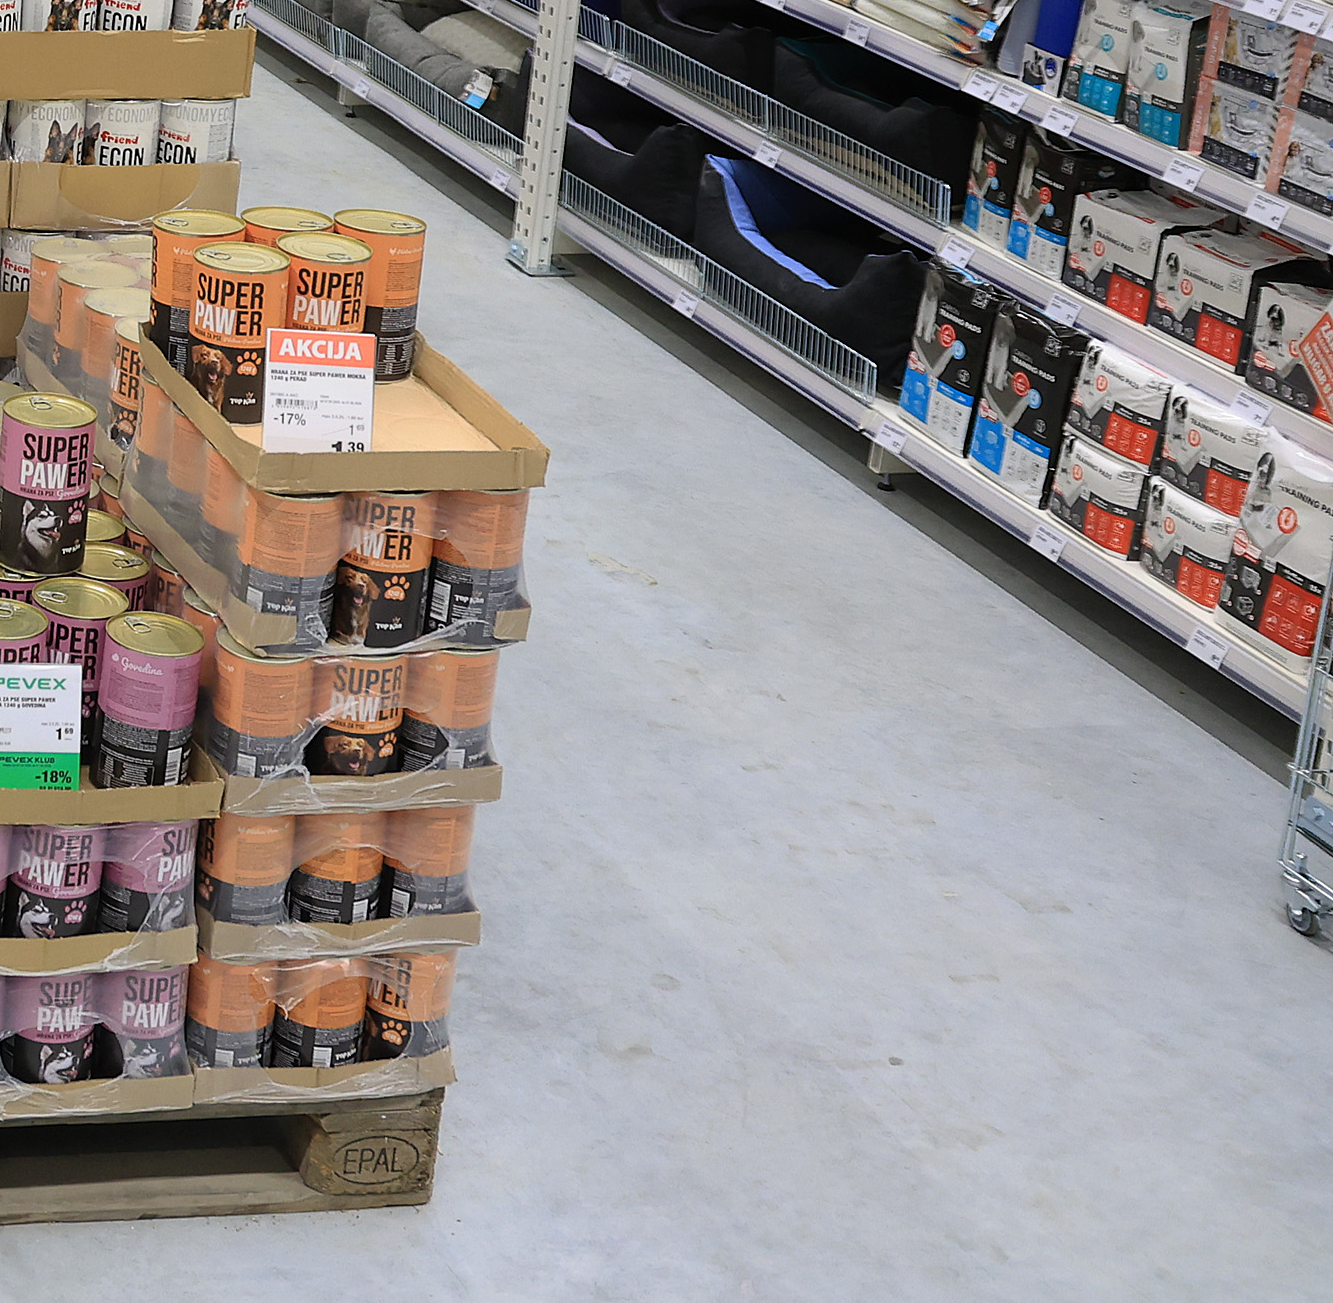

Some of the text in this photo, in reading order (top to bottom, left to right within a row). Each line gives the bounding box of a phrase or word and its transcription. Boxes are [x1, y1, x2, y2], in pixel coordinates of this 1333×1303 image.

[100, 130, 139, 145] friend
[198, 272, 264, 309] SUPER
[297, 268, 364, 299] SUPER
[195, 299, 263, 336] PAWER
[293, 295, 361, 326] PAWER
[939, 308, 982, 334] TRAINING PADS
[279, 338, 362, 360] AKCIJA
[1012, 356, 1055, 383] TRAINING PADS
[274, 413, 306, 426] -17%
[23, 433, 89, 463] SUPER
[348, 442, 364, 452] 39
[20, 460, 87, 489] PAWER
[334, 664, 403, 695] SUPER
[332, 692, 400, 722] PAWER
[56, 728, 61, 740] 1
[35, 770, 71, 783] -18%
[342, 1144, 404, 1176] EPAL
